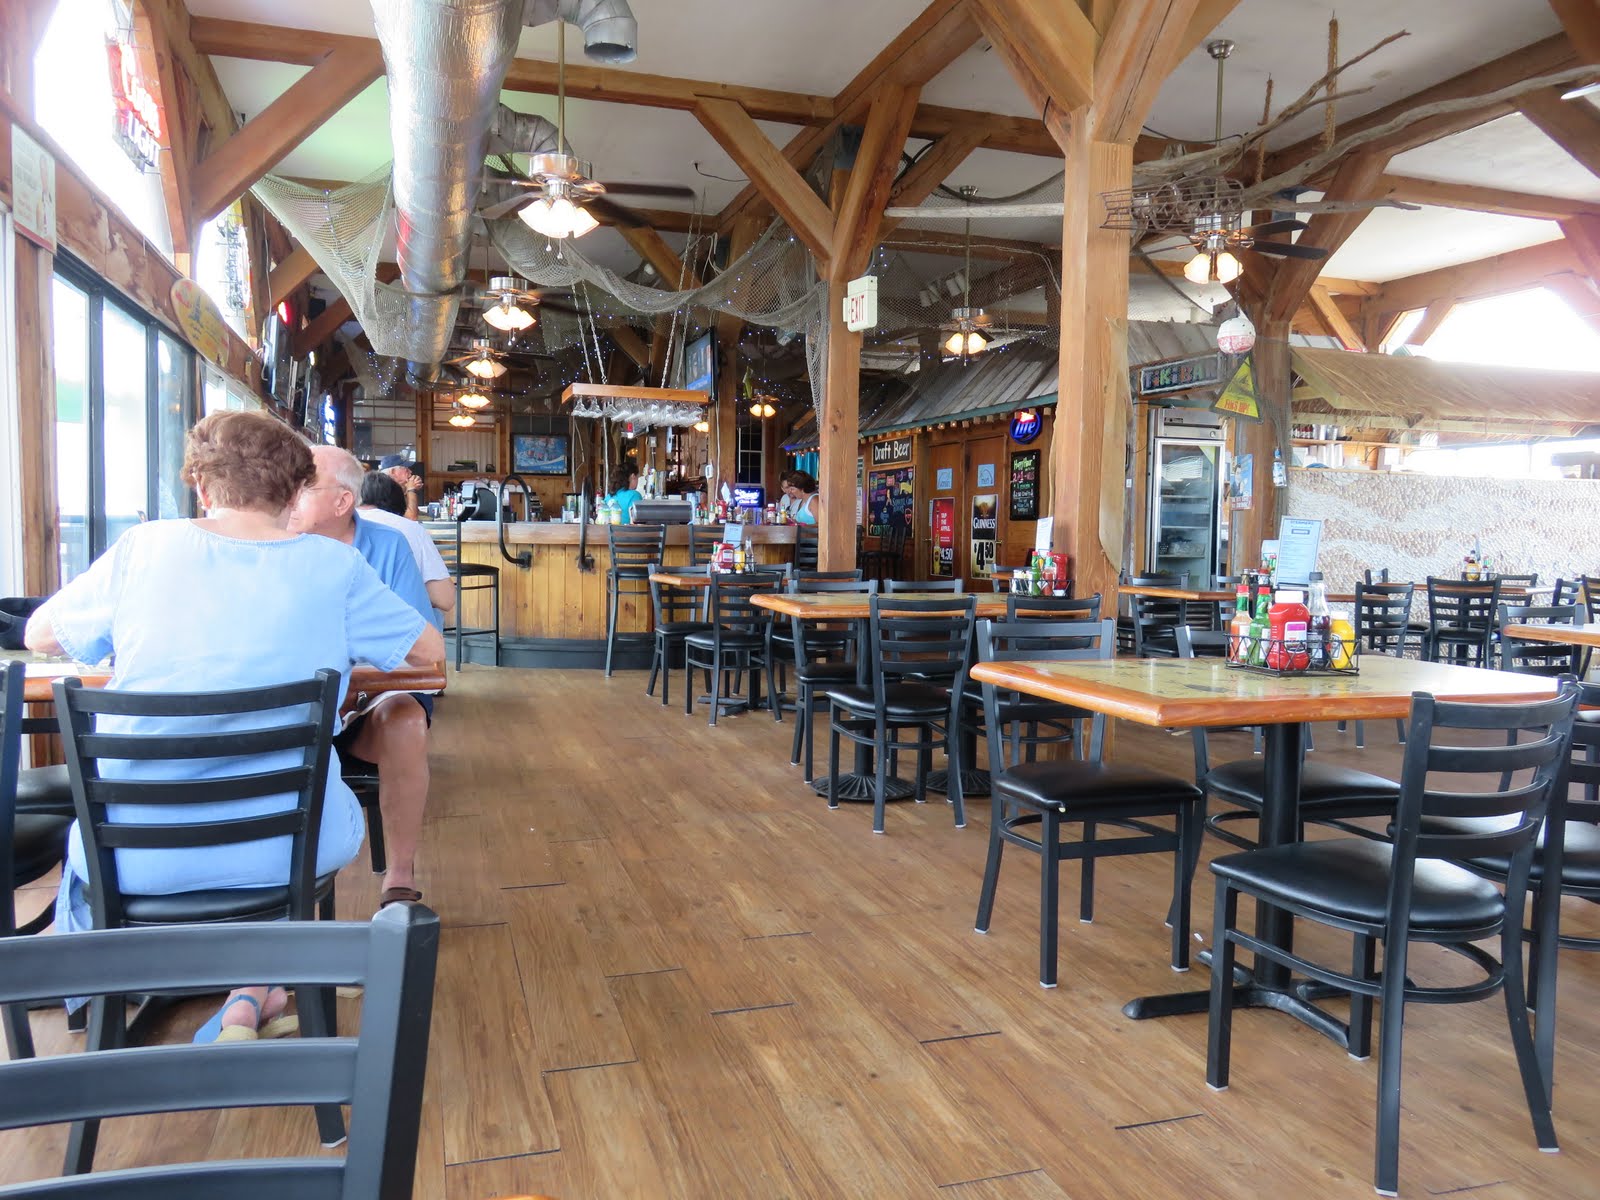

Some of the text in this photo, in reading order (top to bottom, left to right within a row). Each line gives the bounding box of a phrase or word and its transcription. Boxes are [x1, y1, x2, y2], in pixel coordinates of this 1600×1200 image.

[851, 295, 864, 323] EXIT
[1224, 399, 1238, 410] FINS
[874, 440, 910, 461] Draft Beer
[973, 517, 996, 529] GUINNESS
